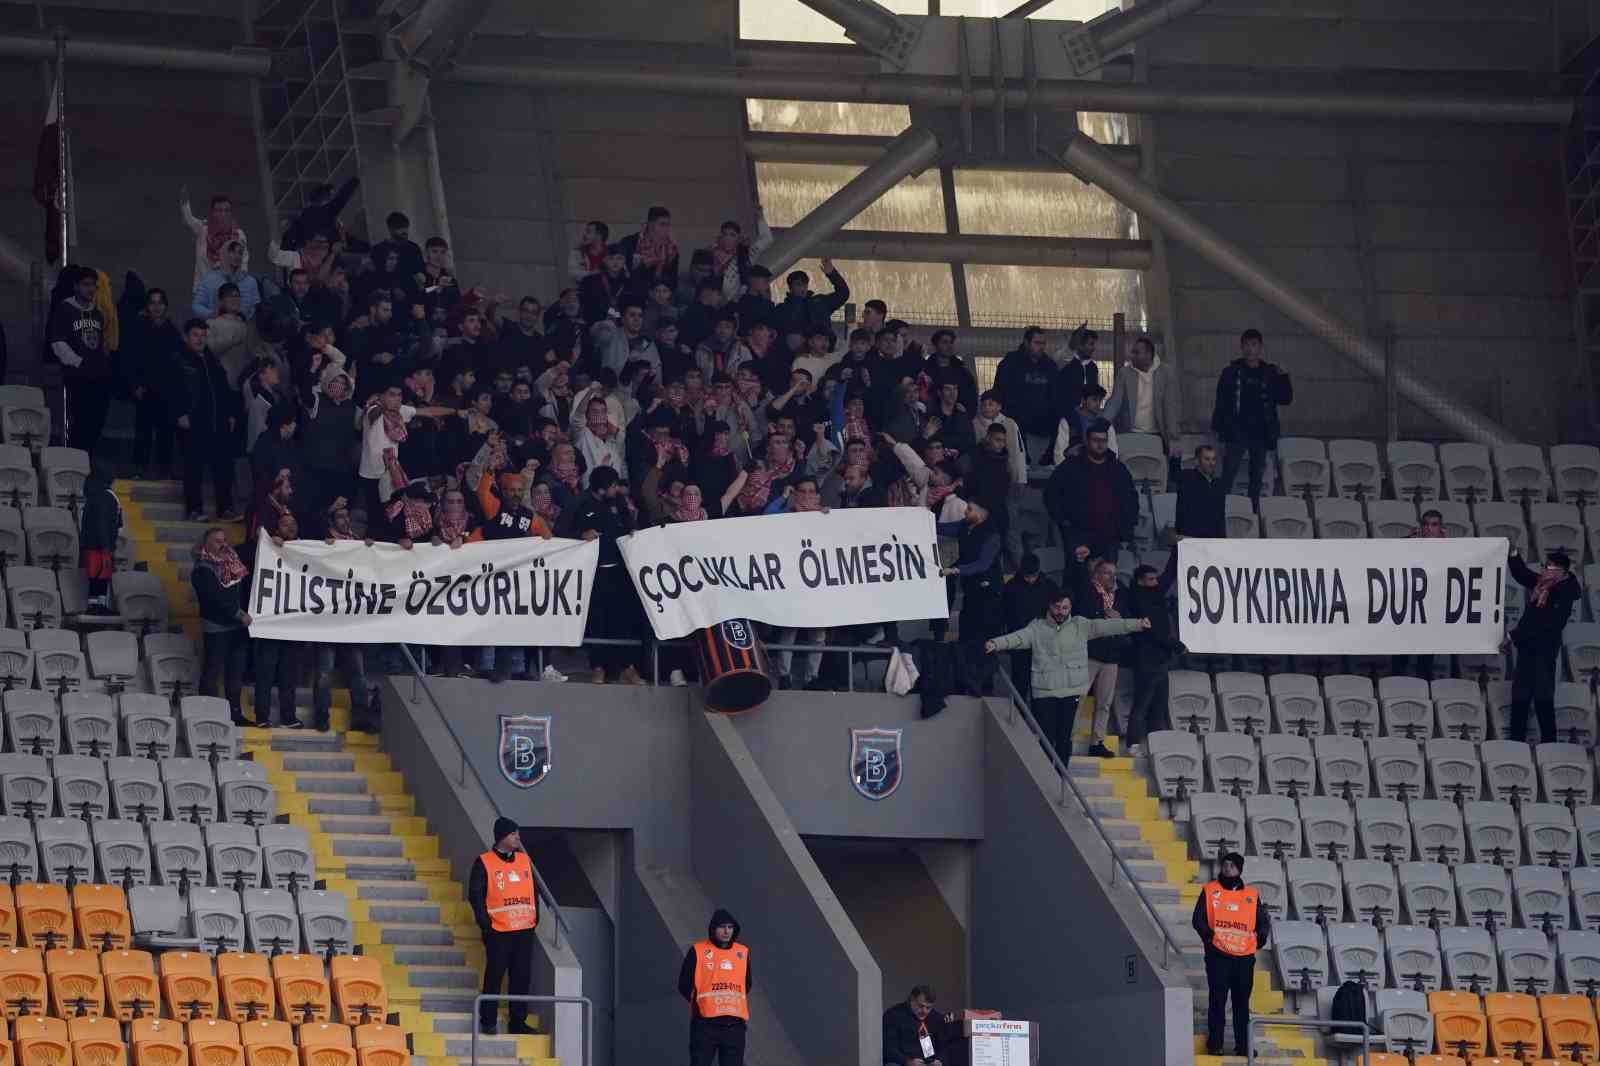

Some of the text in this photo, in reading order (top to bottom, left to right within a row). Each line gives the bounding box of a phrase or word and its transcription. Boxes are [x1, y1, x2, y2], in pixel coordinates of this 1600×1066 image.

[256, 557, 583, 616] FİLİSTİNE ÖZGÜRLÜK!
[639, 553, 786, 613] ÇOCUKLAR
[800, 535, 927, 589] ÖLMESİN
[1186, 566, 1350, 625] SOYKIRIMA
[1367, 567, 1428, 625] DUR
[1445, 567, 1483, 624] DE
